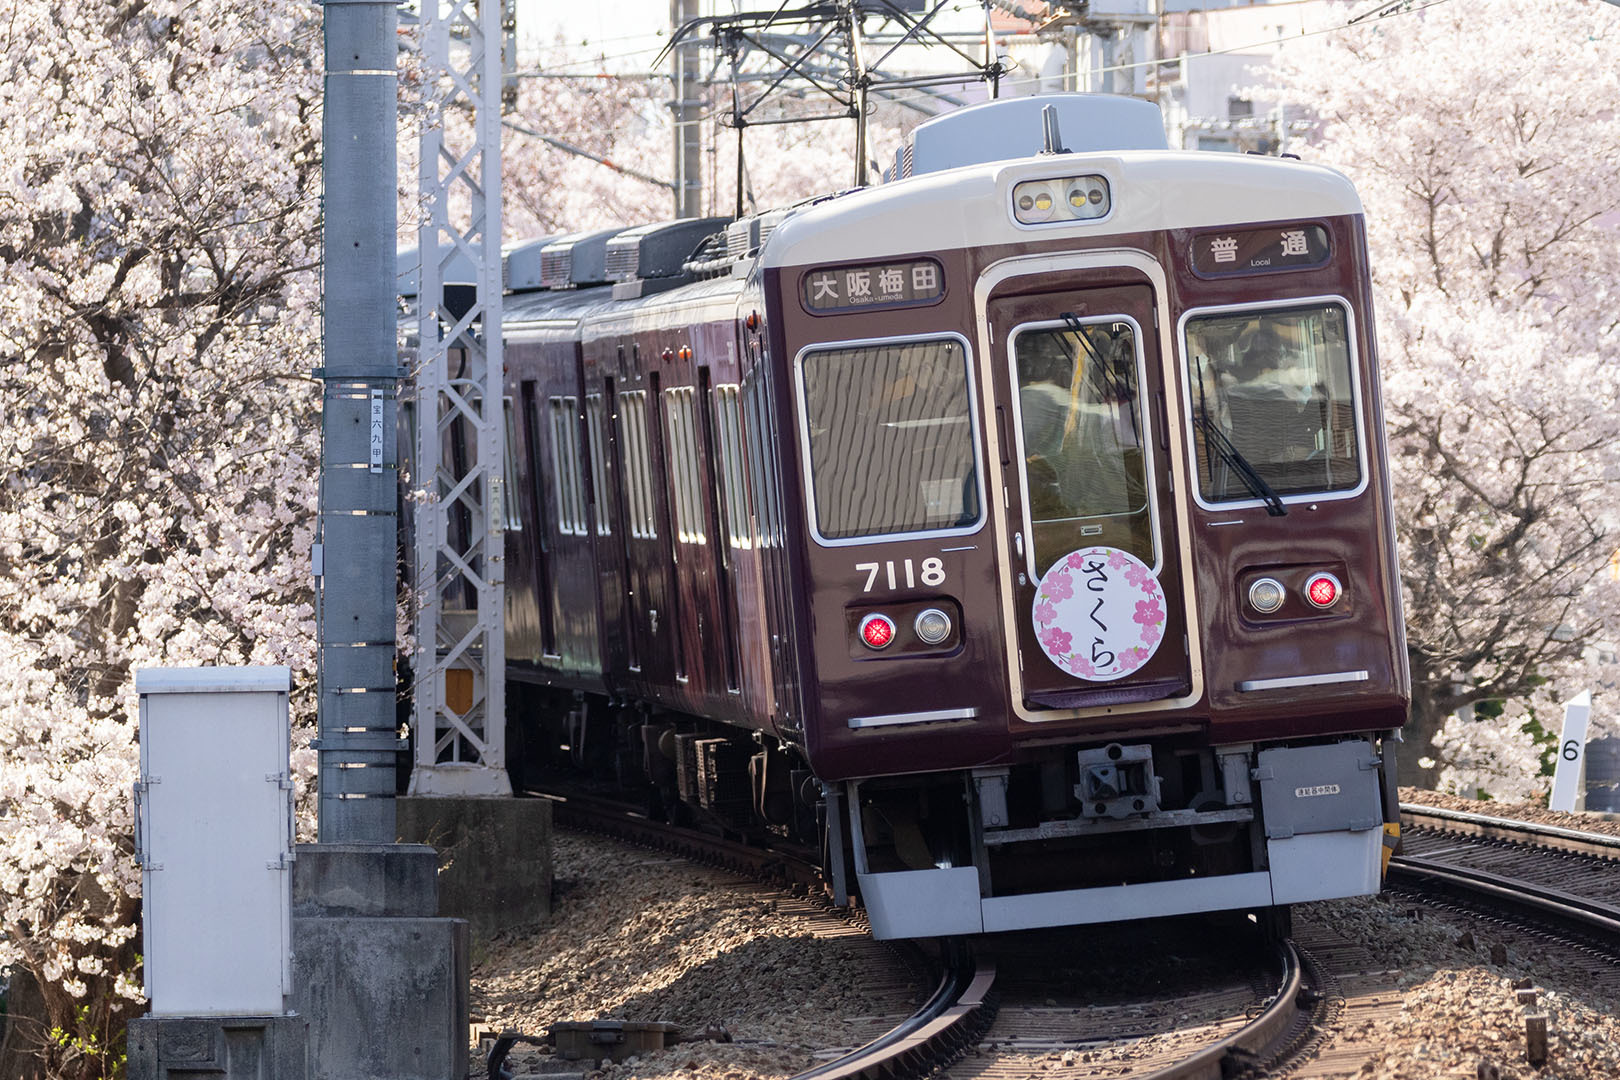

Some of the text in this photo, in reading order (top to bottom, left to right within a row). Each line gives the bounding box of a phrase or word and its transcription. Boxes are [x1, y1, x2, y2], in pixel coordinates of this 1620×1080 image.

[1211, 230, 1309, 263] 普通
[1250, 258, 1271, 267] Local
[813, 265, 937, 301] 大阪梅田
[371, 404, 382, 458] 宝六九甲
[855, 557, 946, 593] 7118
[1082, 560, 1115, 668] さくら
[1562, 739, 1580, 761] 6
